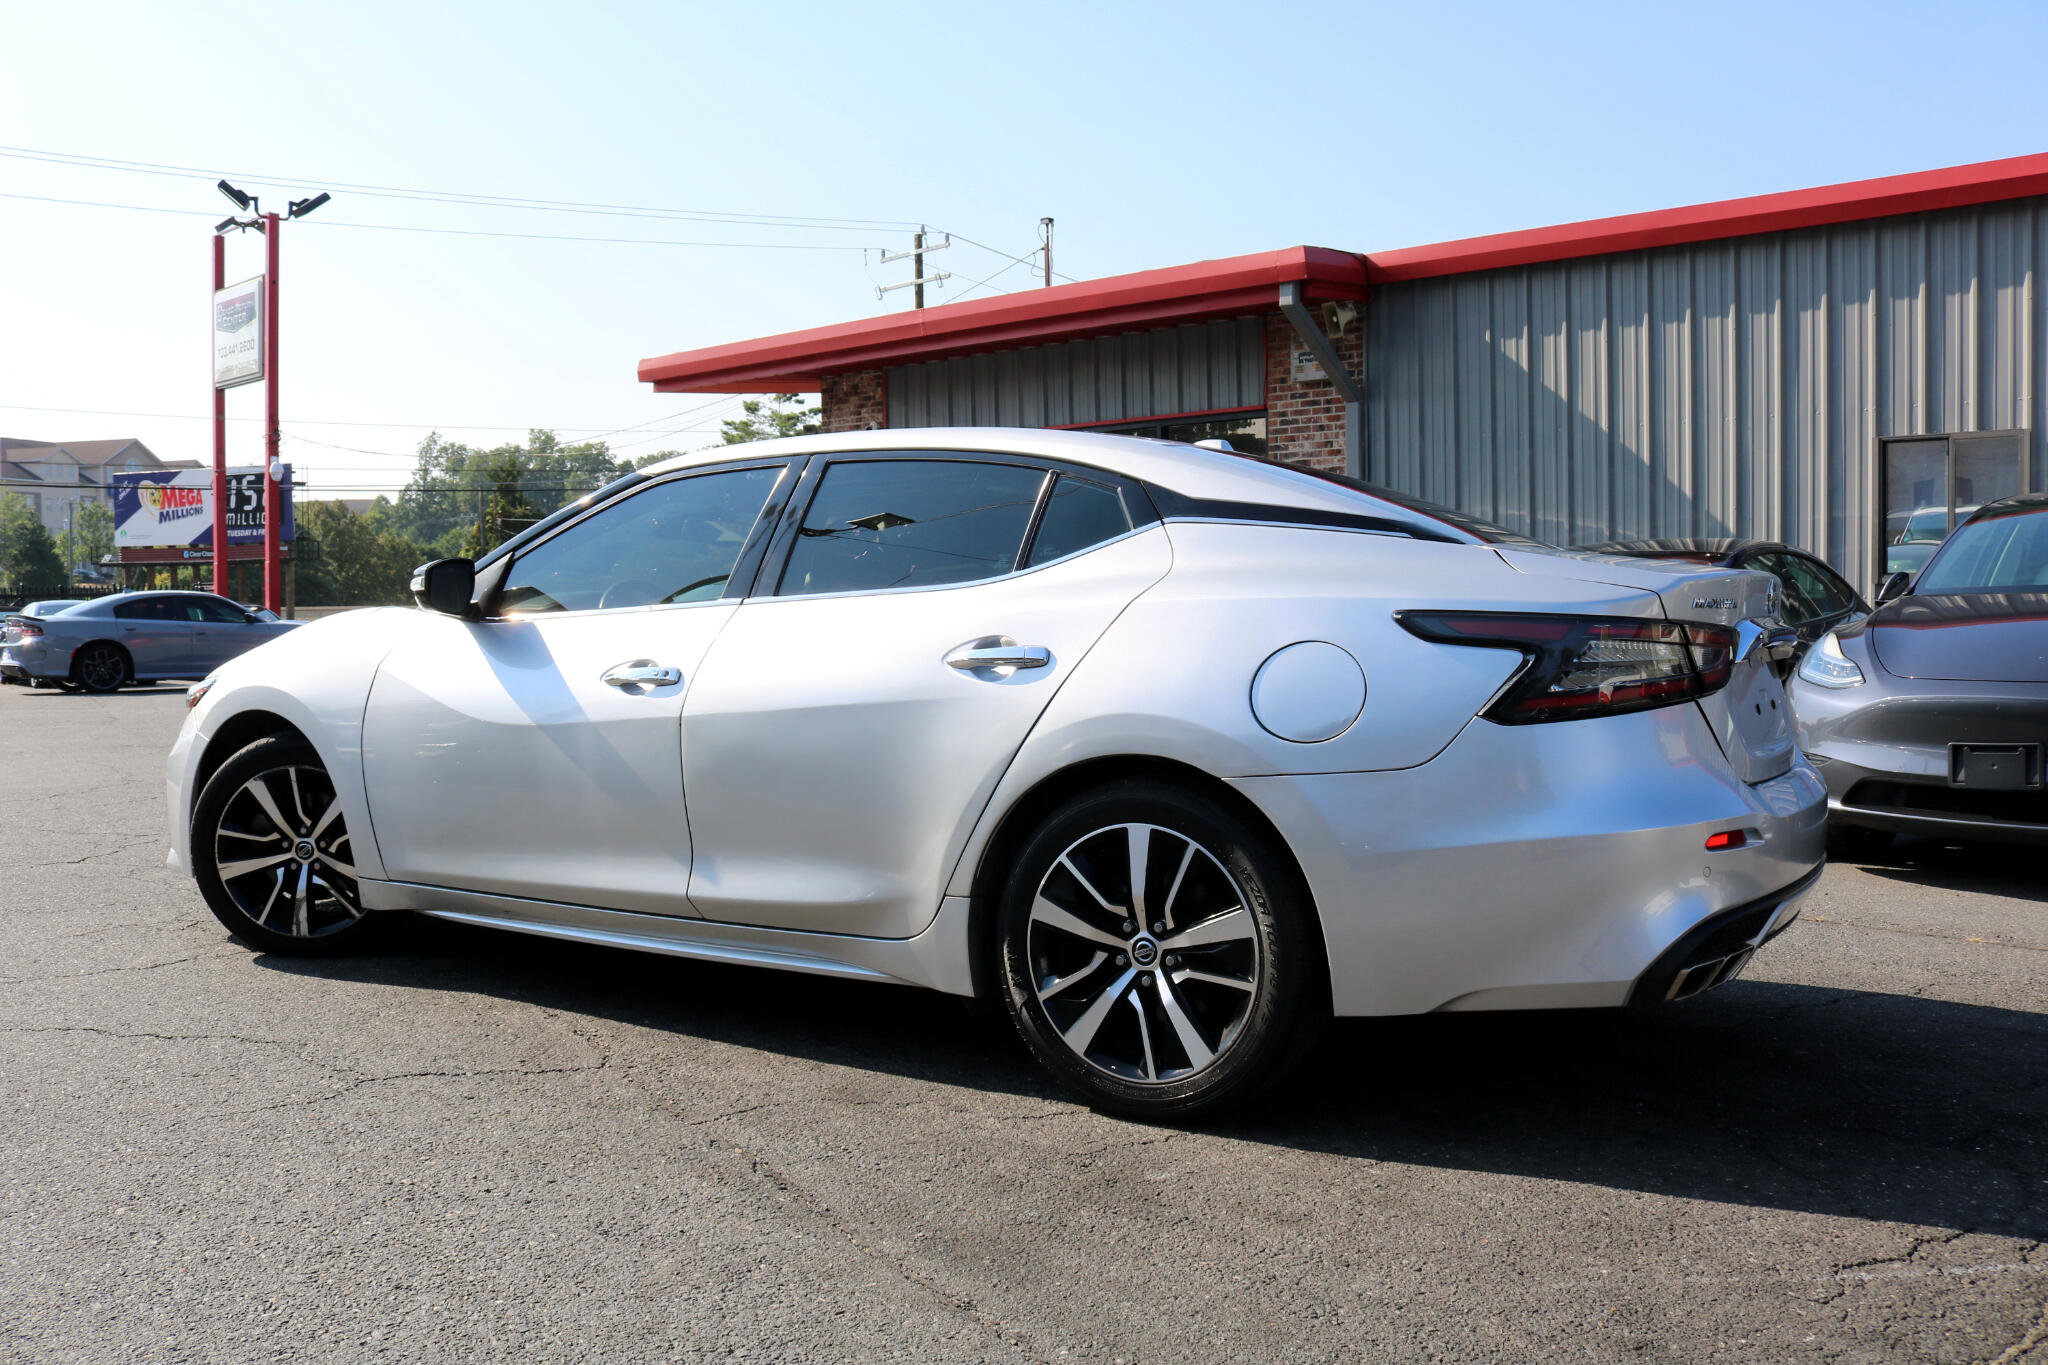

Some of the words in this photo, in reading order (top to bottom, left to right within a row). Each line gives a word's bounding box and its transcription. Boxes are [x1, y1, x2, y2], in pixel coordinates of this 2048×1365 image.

[160, 485, 203, 510] MEGA
[158, 506, 204, 524] MILLIONS
[227, 529, 252, 537] TUESDAY
